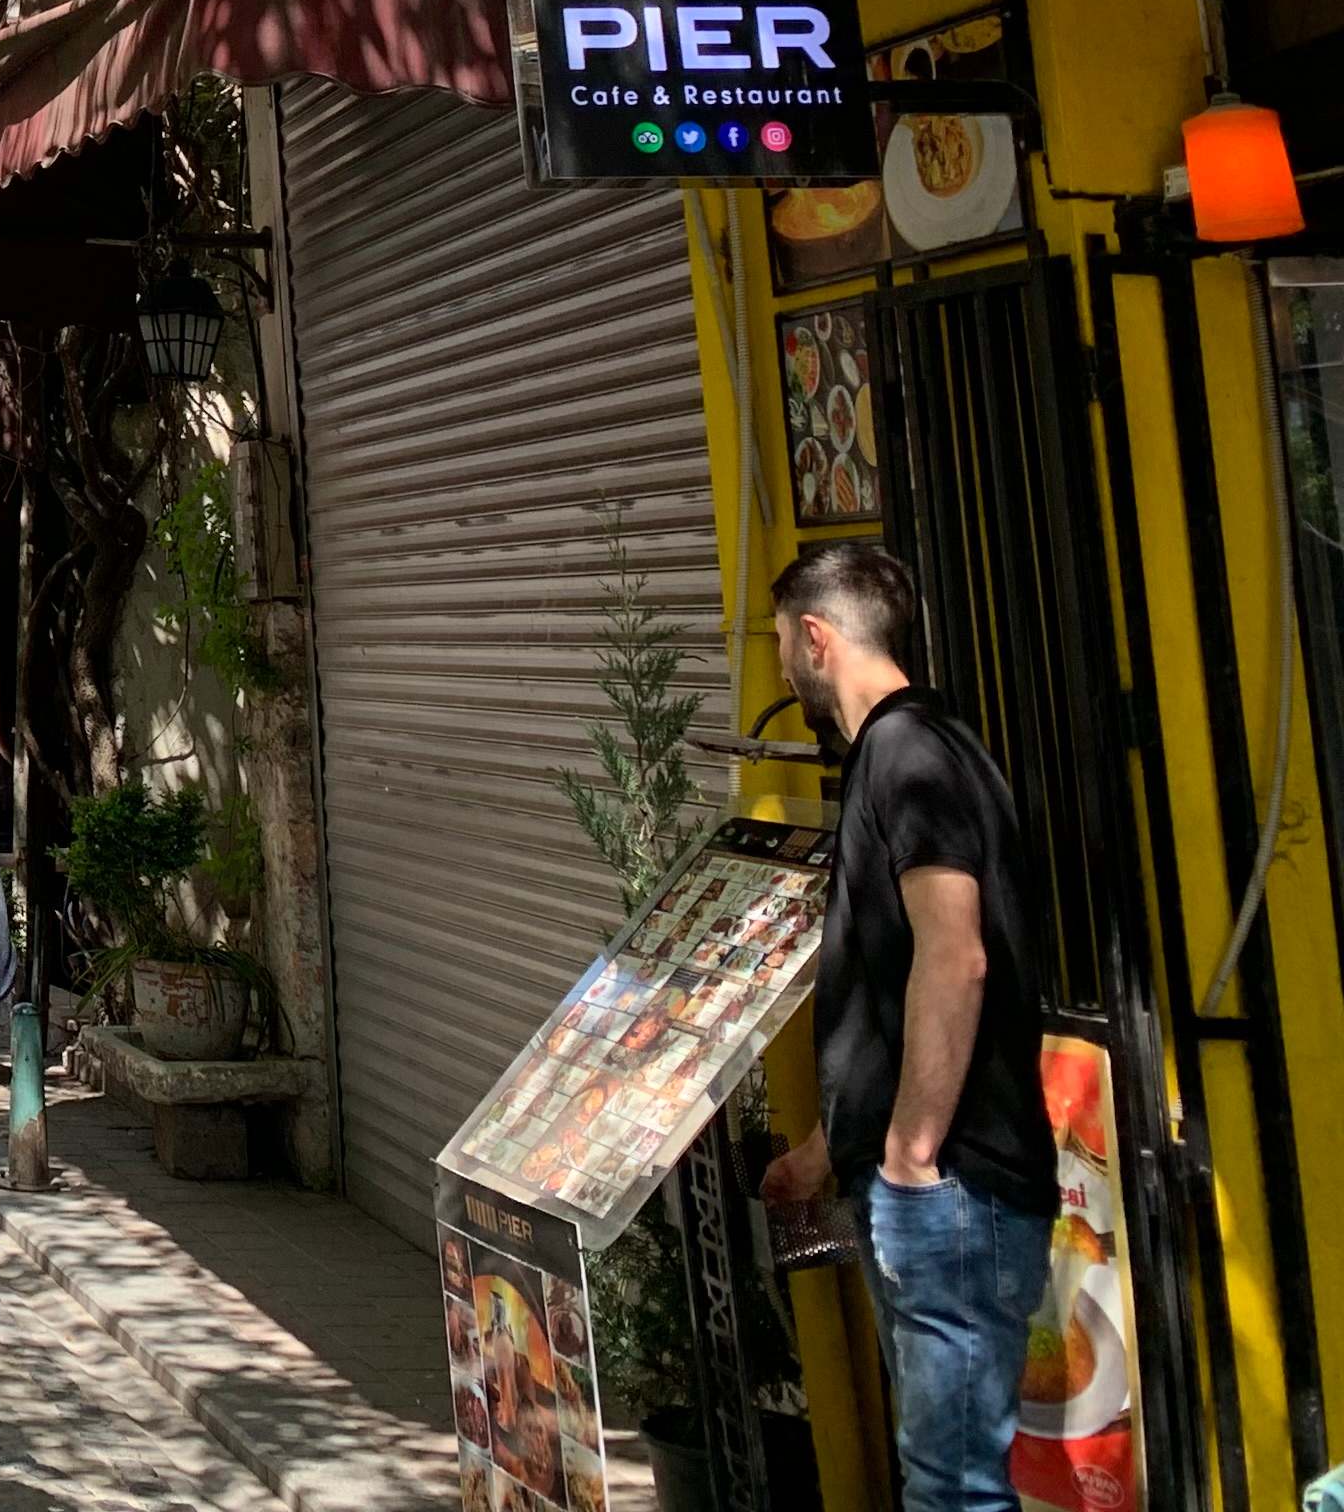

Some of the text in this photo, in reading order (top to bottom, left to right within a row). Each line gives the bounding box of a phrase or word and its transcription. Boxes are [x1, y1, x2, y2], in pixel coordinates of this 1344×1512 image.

[562, 6, 837, 72] PIER
[570, 84, 844, 107] Cafe & Restaurant
[497, 1209, 534, 1243] PIER
